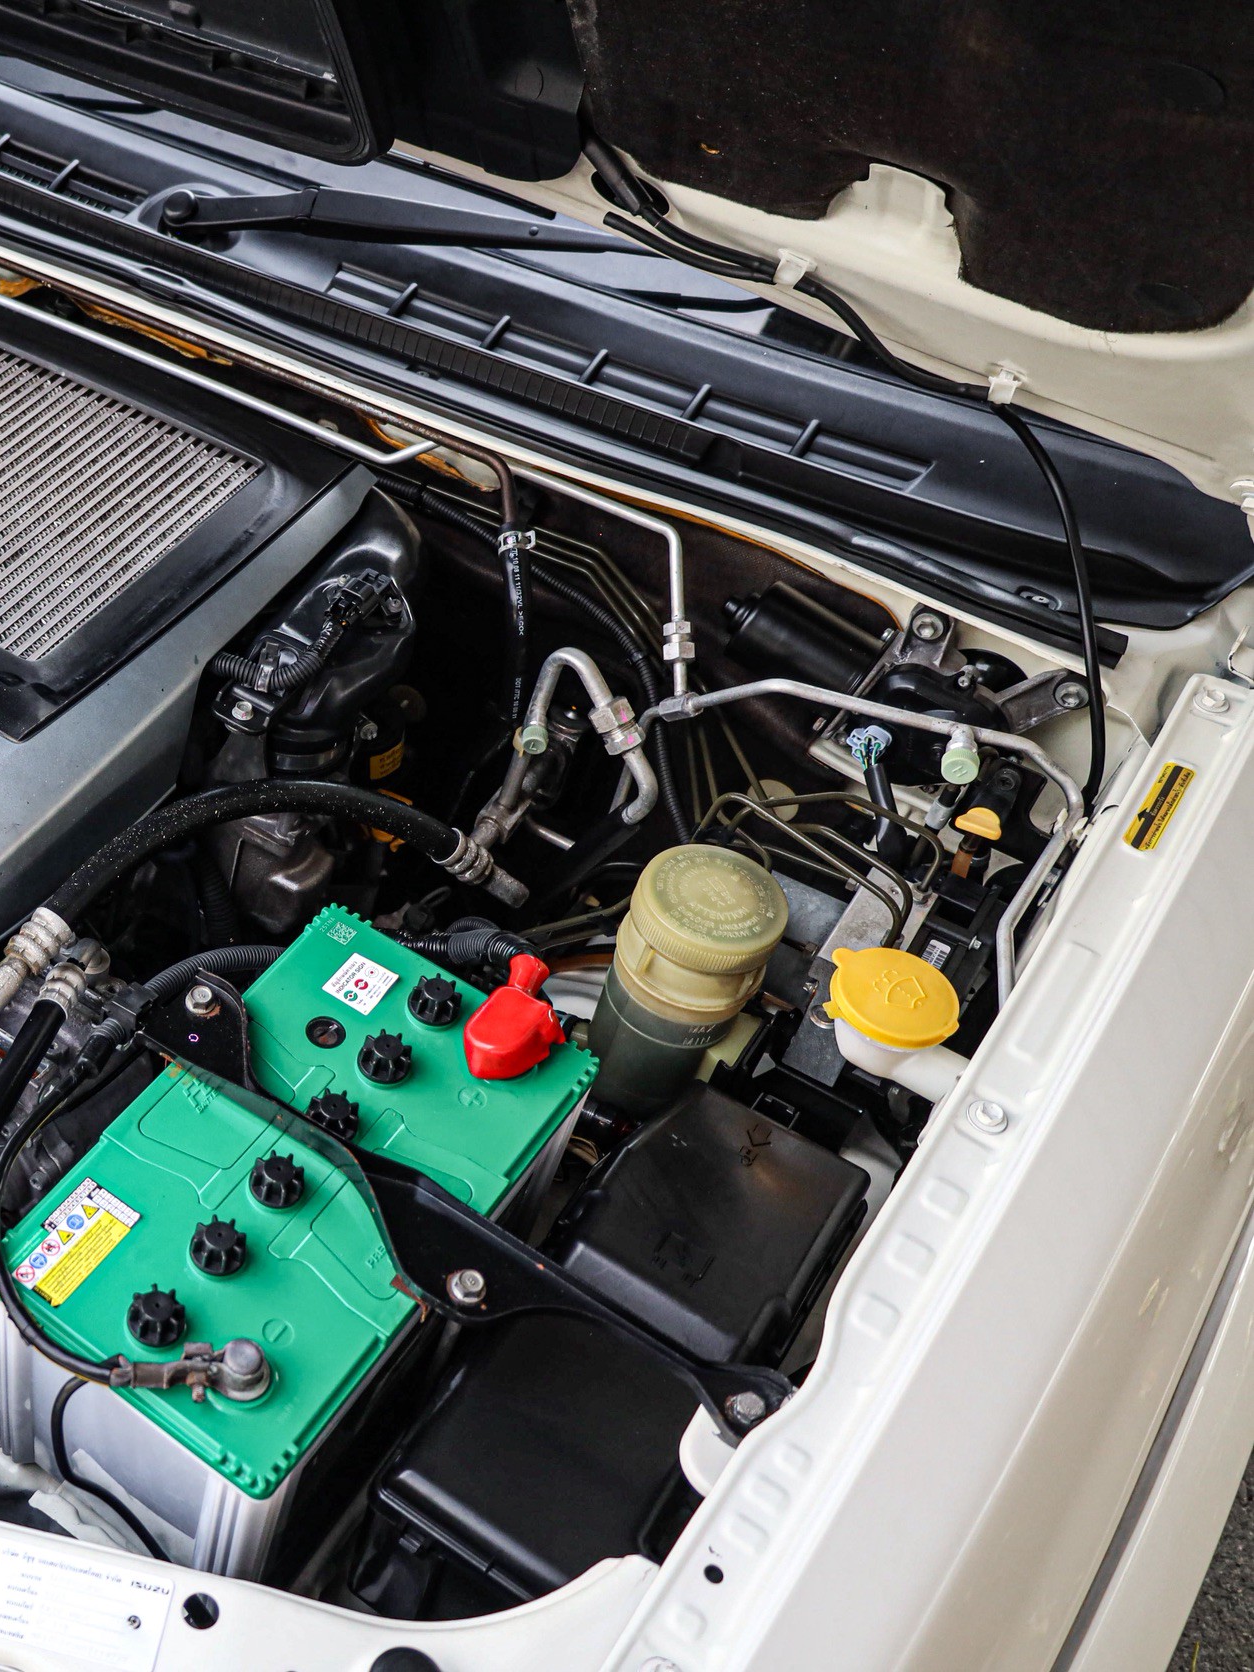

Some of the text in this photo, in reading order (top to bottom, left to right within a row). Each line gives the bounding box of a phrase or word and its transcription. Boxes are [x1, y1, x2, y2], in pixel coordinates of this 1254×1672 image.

[687, 901, 750, 921] ATTENTION
[335, 961, 366, 994] INDICATOR SIGN
[683, 1035, 711, 1047] MIN
[130, 1580, 170, 1595] ISUZU
